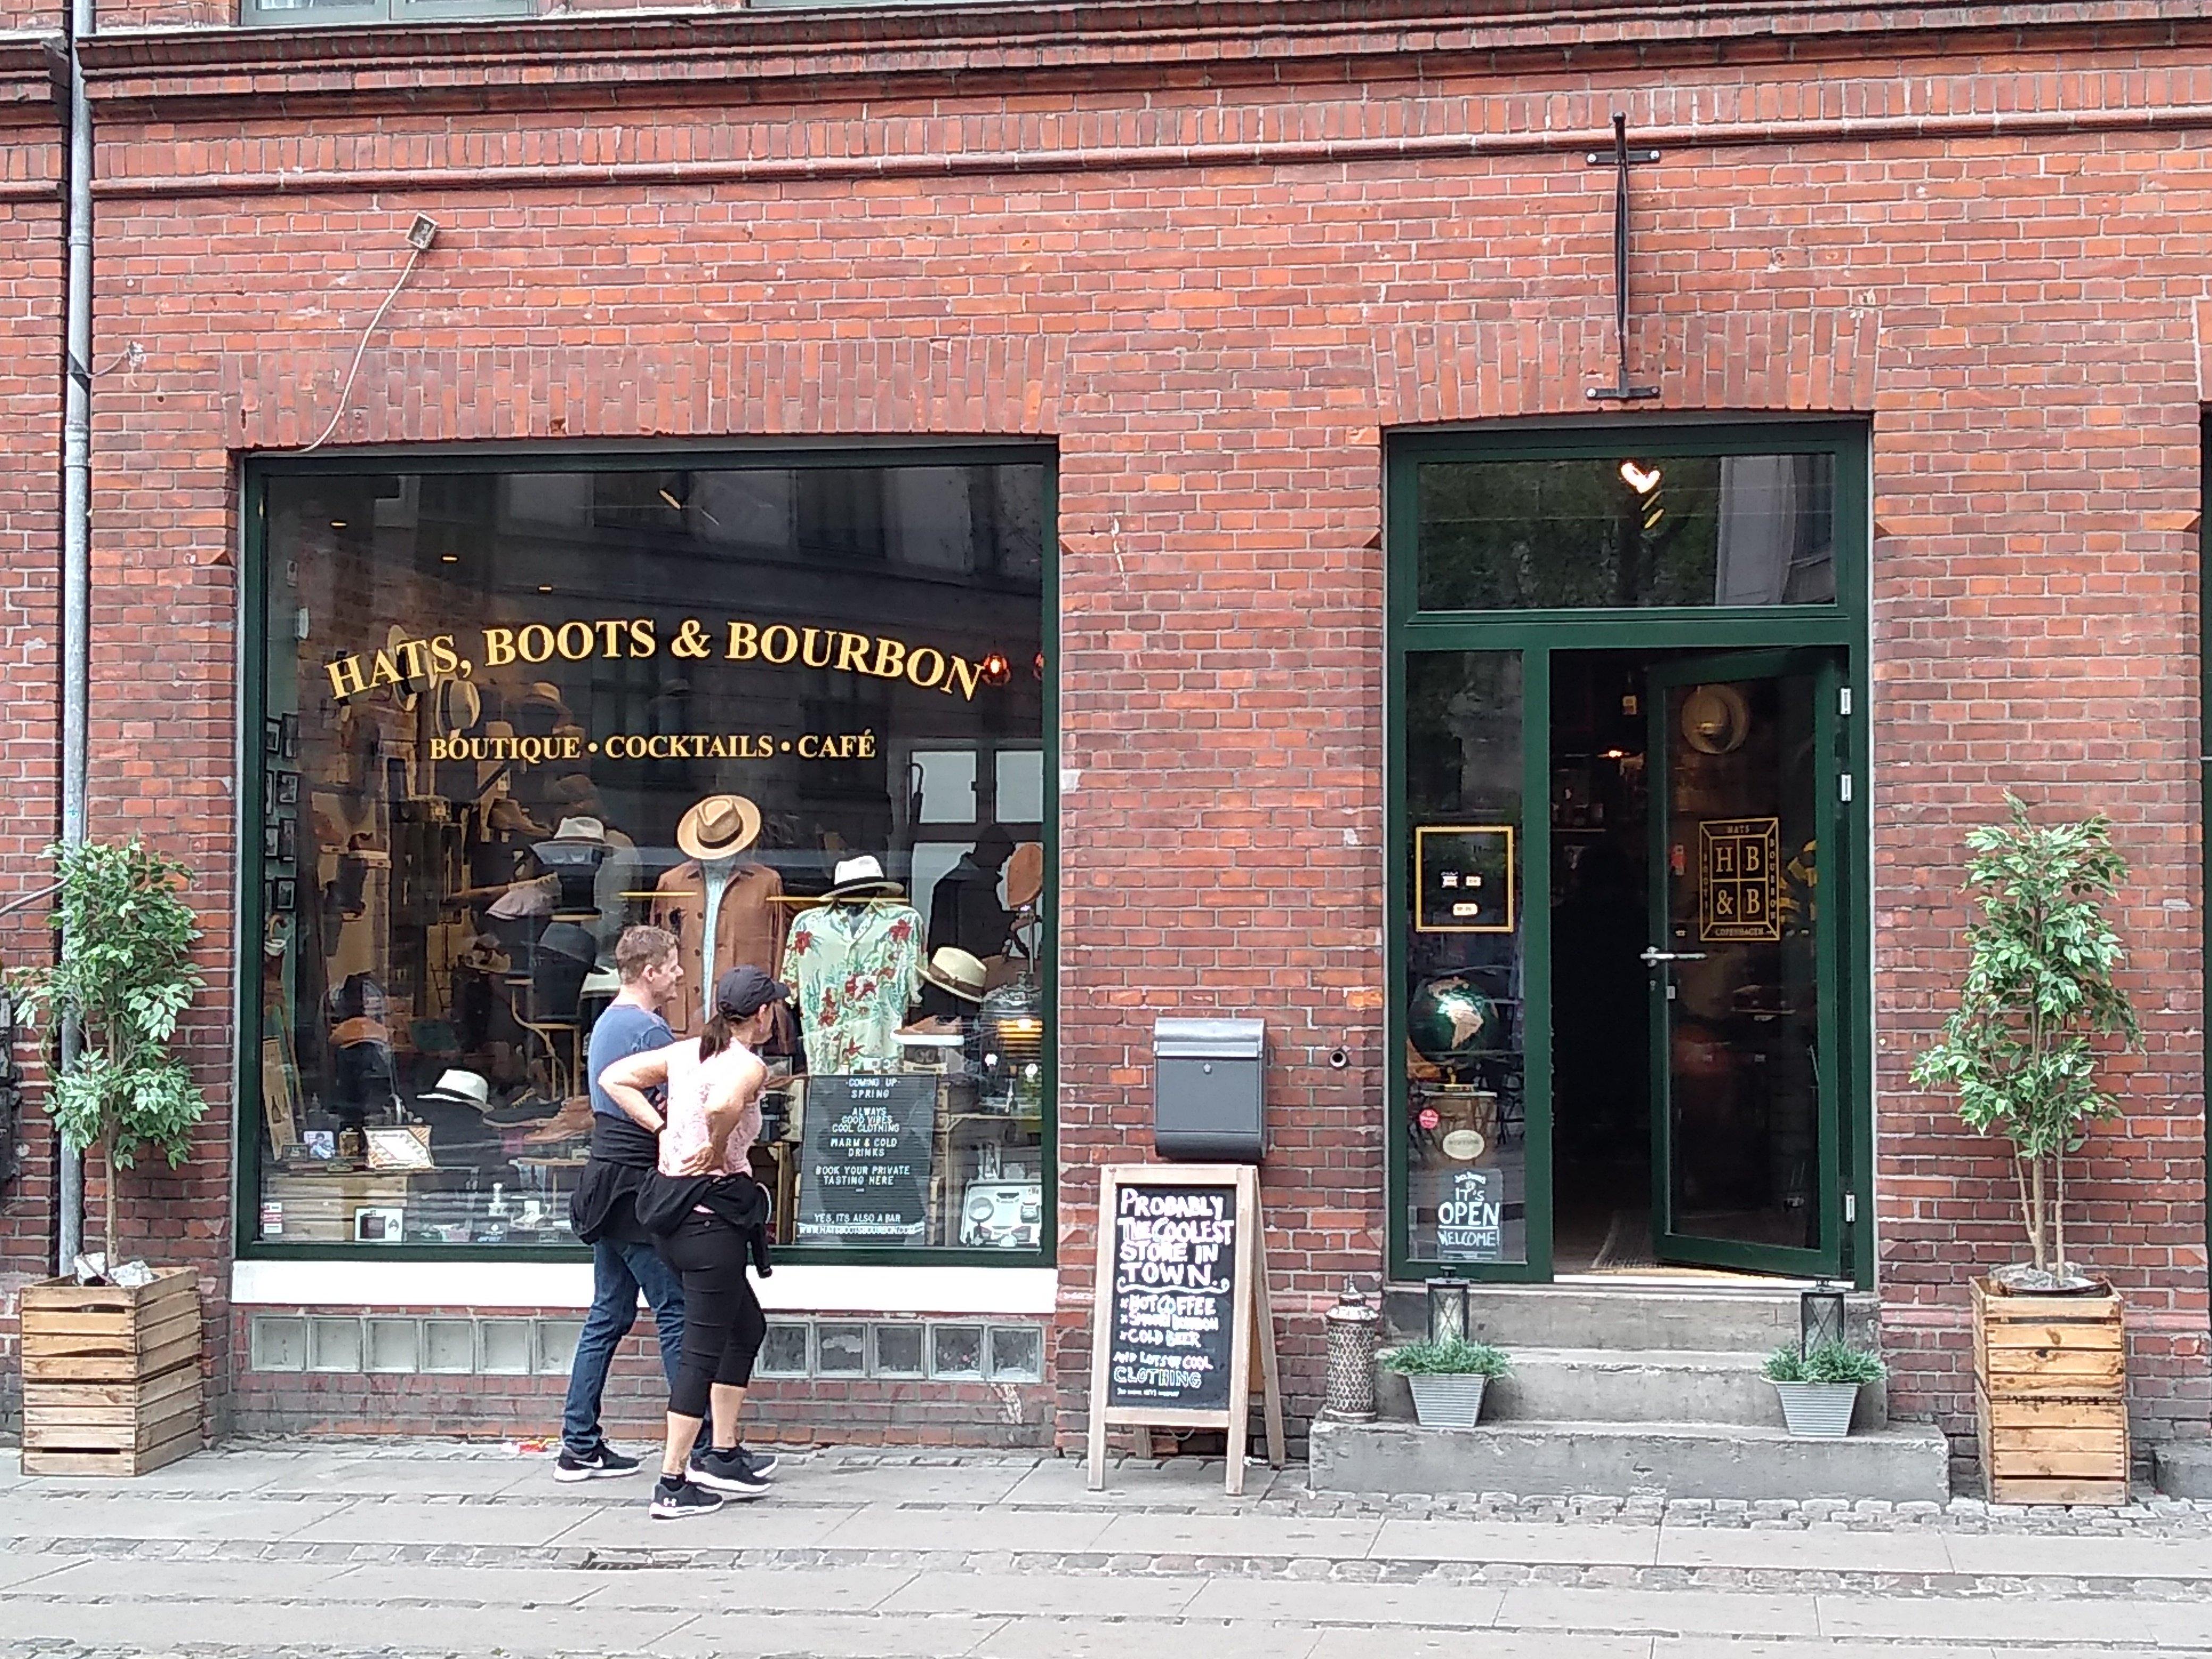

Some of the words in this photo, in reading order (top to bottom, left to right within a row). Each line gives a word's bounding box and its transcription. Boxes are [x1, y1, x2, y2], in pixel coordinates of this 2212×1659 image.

[324, 634, 472, 700] HATS,
[482, 619, 656, 667] BOOTS
[671, 619, 711, 658] &
[724, 620, 985, 701] BOURBON
[430, 736, 581, 763] BOUTIQUE
[606, 734, 773, 758] COCKTAILS
[798, 728, 876, 758] CAFÉ
[1716, 847, 1733, 873] H
[1746, 846, 1760, 871] B
[1716, 890, 1733, 915] &
[1747, 889, 1760, 914] B
[851, 1089, 890, 1099] SPRING
[841, 1115, 865, 1124] GOOD
[867, 1115, 893, 1125] VIBES
[852, 1107, 887, 1116] ALWAYS
[832, 1123, 854, 1133] COOL
[857, 1123, 900, 1133] CLOTHING
[864, 1137, 870, 1147] &
[873, 1137, 898, 1147] COLD
[848, 1147, 885, 1157] DRINKS
[815, 1165, 840, 1175] BOOK
[844, 1165, 869, 1175] YOUR
[872, 1165, 910, 1175] PRIVATE
[824, 1175, 865, 1185] TASTING
[868, 1175, 894, 1185] HERE
[1120, 1188, 1223, 1220] PROBABLY
[1455, 1187, 1485, 1202] IT'S
[853, 1213, 875, 1222] ALSO
[877, 1213, 883, 1222] A
[885, 1213, 901, 1223] BAR
[1438, 1201, 1499, 1226] OPEN
[1152, 1217, 1234, 1245] COOLEST
[1437, 1229, 1499, 1246] WELCOME!
[1120, 1239, 1188, 1262] STORE
[1195, 1244, 1218, 1264] IN
[1120, 1262, 1218, 1287] TOWN.
[1129, 1294, 1159, 1312] HOT
[1157, 1294, 1216, 1316] COFFEE
[1128, 1328, 1163, 1345] COLD
[1166, 1329, 1201, 1347] BEER
[1113, 1351, 1137, 1363] AND
[1183, 1355, 1213, 1371] COOL
[1113, 1366, 1202, 1389] CLOTHING
